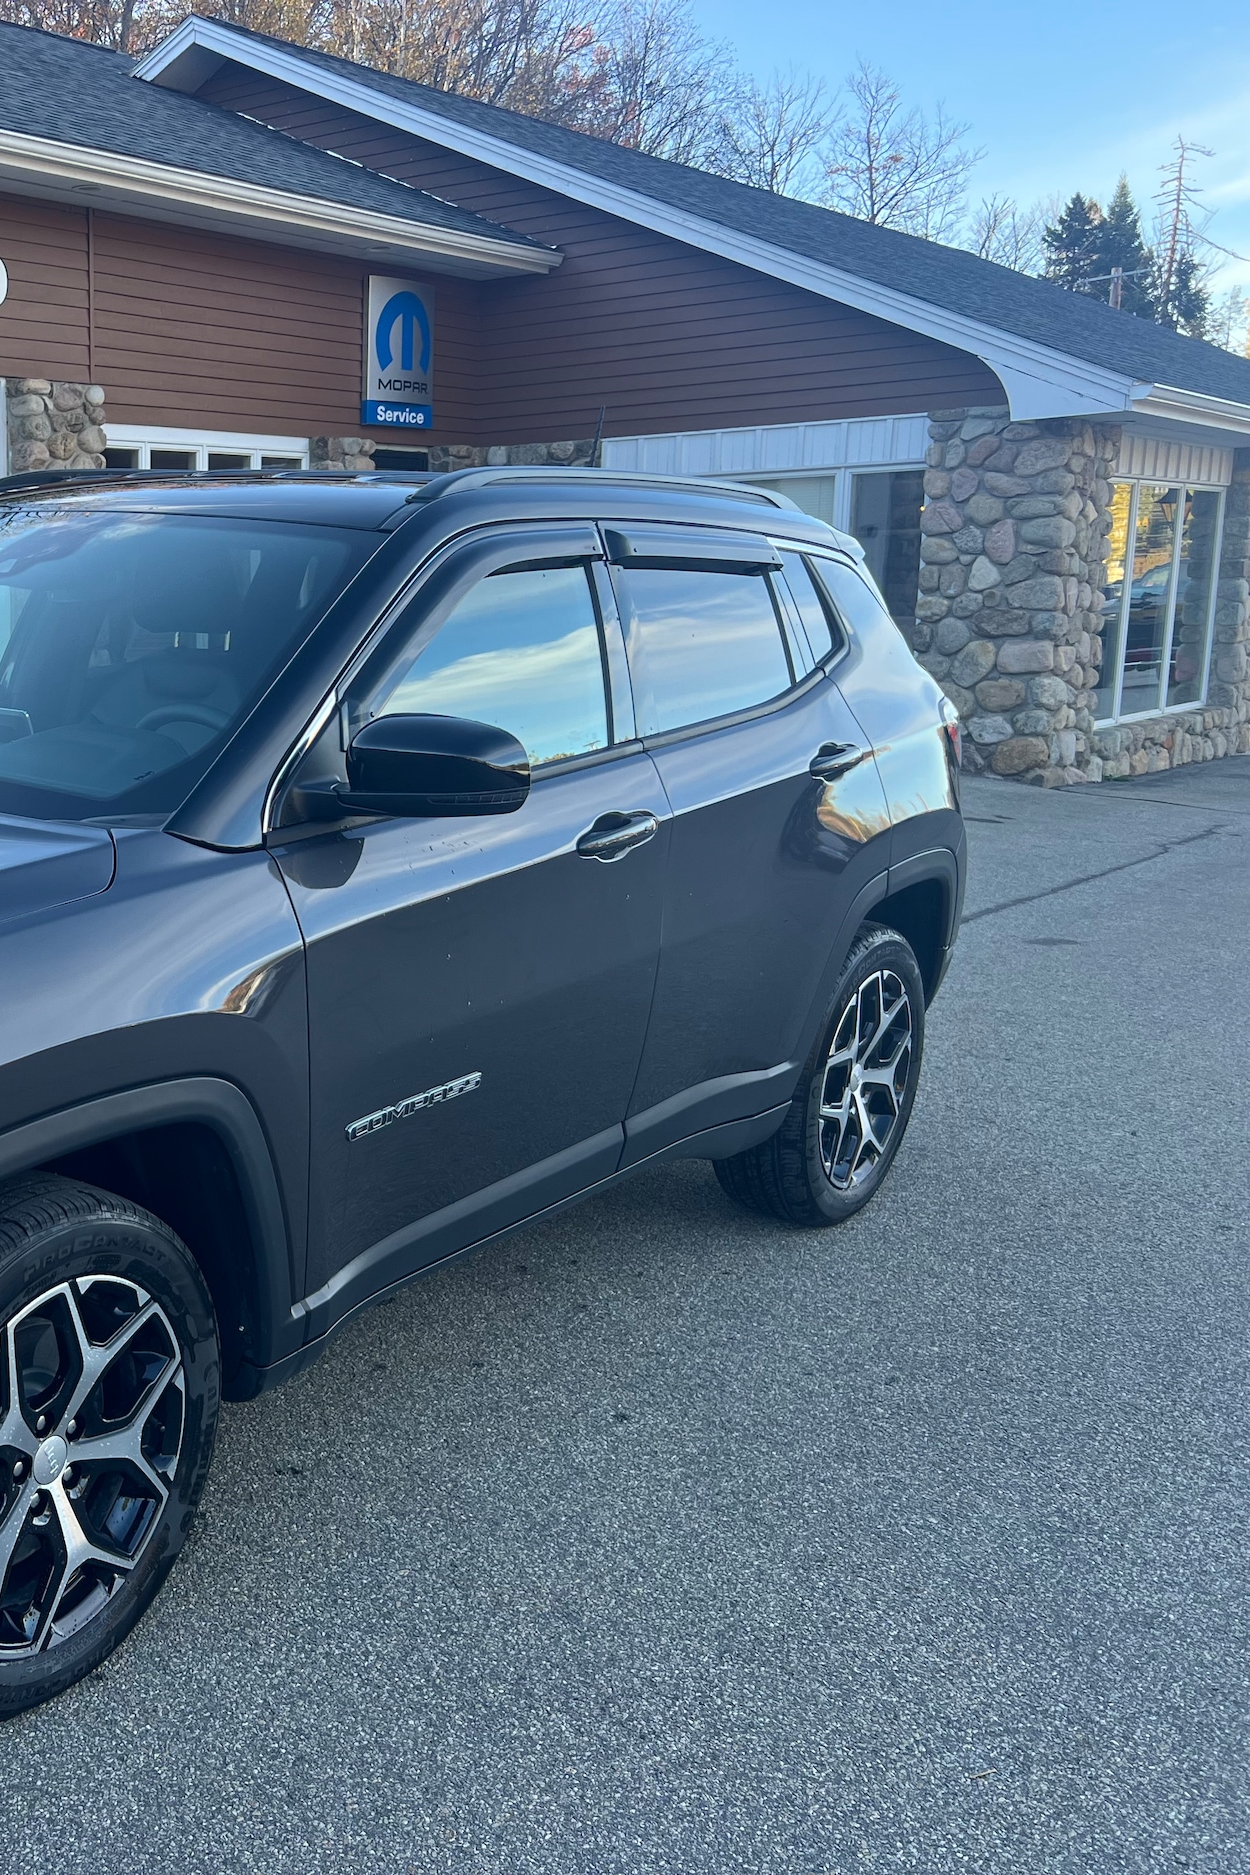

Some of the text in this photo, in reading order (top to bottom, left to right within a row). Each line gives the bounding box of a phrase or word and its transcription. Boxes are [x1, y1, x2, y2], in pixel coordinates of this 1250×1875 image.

[377, 378, 429, 394] MOPAR
[376, 405, 425, 425] Service
[345, 1070, 482, 1142] COMPASS
